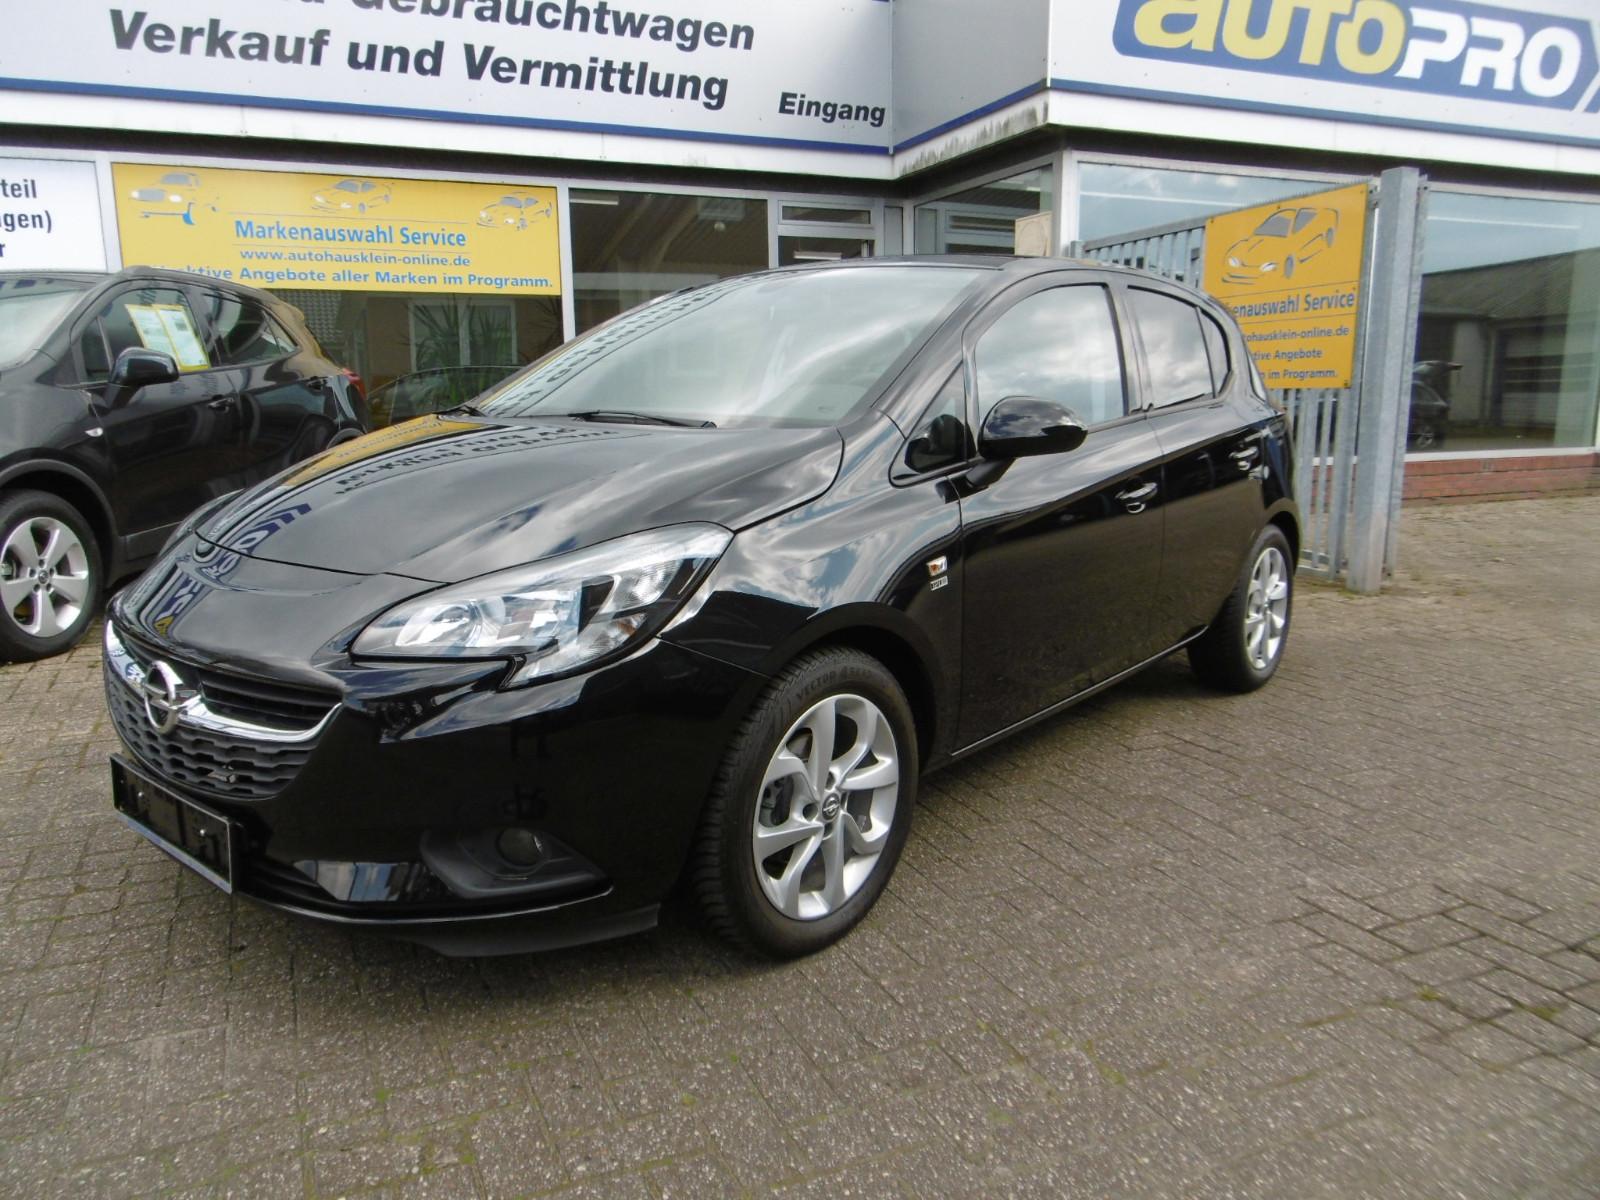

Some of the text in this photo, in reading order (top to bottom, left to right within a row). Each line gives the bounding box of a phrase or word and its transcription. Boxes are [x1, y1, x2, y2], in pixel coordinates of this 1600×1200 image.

[352, 0, 755, 52] ebrauchtwagen
[109, 8, 729, 110] Verkauf und Vermittlung
[778, 91, 886, 128] Eingang
[0, 210, 52, 233] gen)
[234, 219, 467, 246] Markenauswahl Service
[239, 249, 471, 267] www.autohausklein-online.de
[239, 266, 326, 284] Angebote
[331, 270, 369, 283] aller
[375, 271, 438, 285] Marken
[443, 272, 463, 286] im
[468, 273, 553, 290] Programm.
[1231, 290, 1356, 318] enauswahl Service
[1274, 348, 1323, 362] Angebote
[1268, 370, 1281, 379] im
